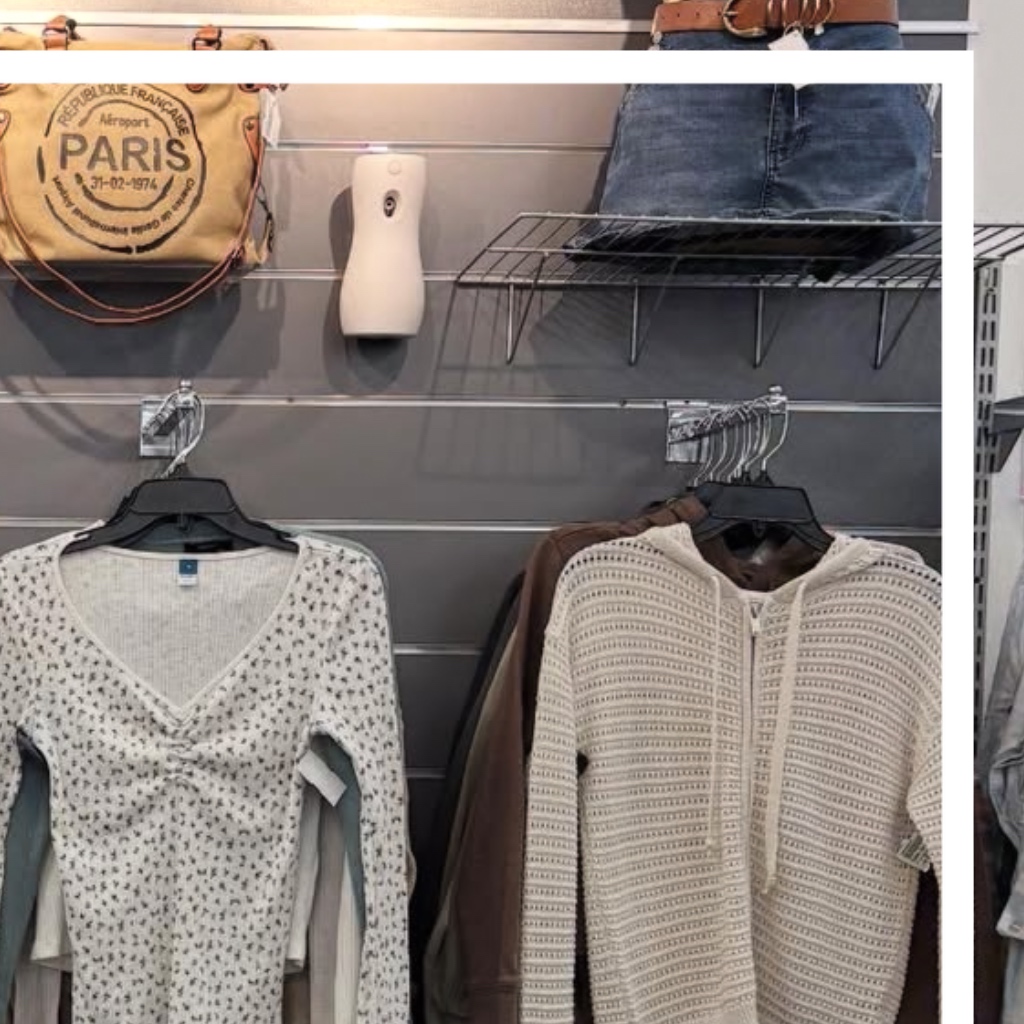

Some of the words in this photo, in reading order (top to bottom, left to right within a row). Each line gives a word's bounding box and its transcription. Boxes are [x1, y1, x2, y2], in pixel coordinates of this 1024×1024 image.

[99, 112, 150, 129] Aéroport
[130, 86, 190, 136] FRANÇAISE
[59, 132, 192, 173] PARIS
[90, 176, 158, 191] 31-02-1974
